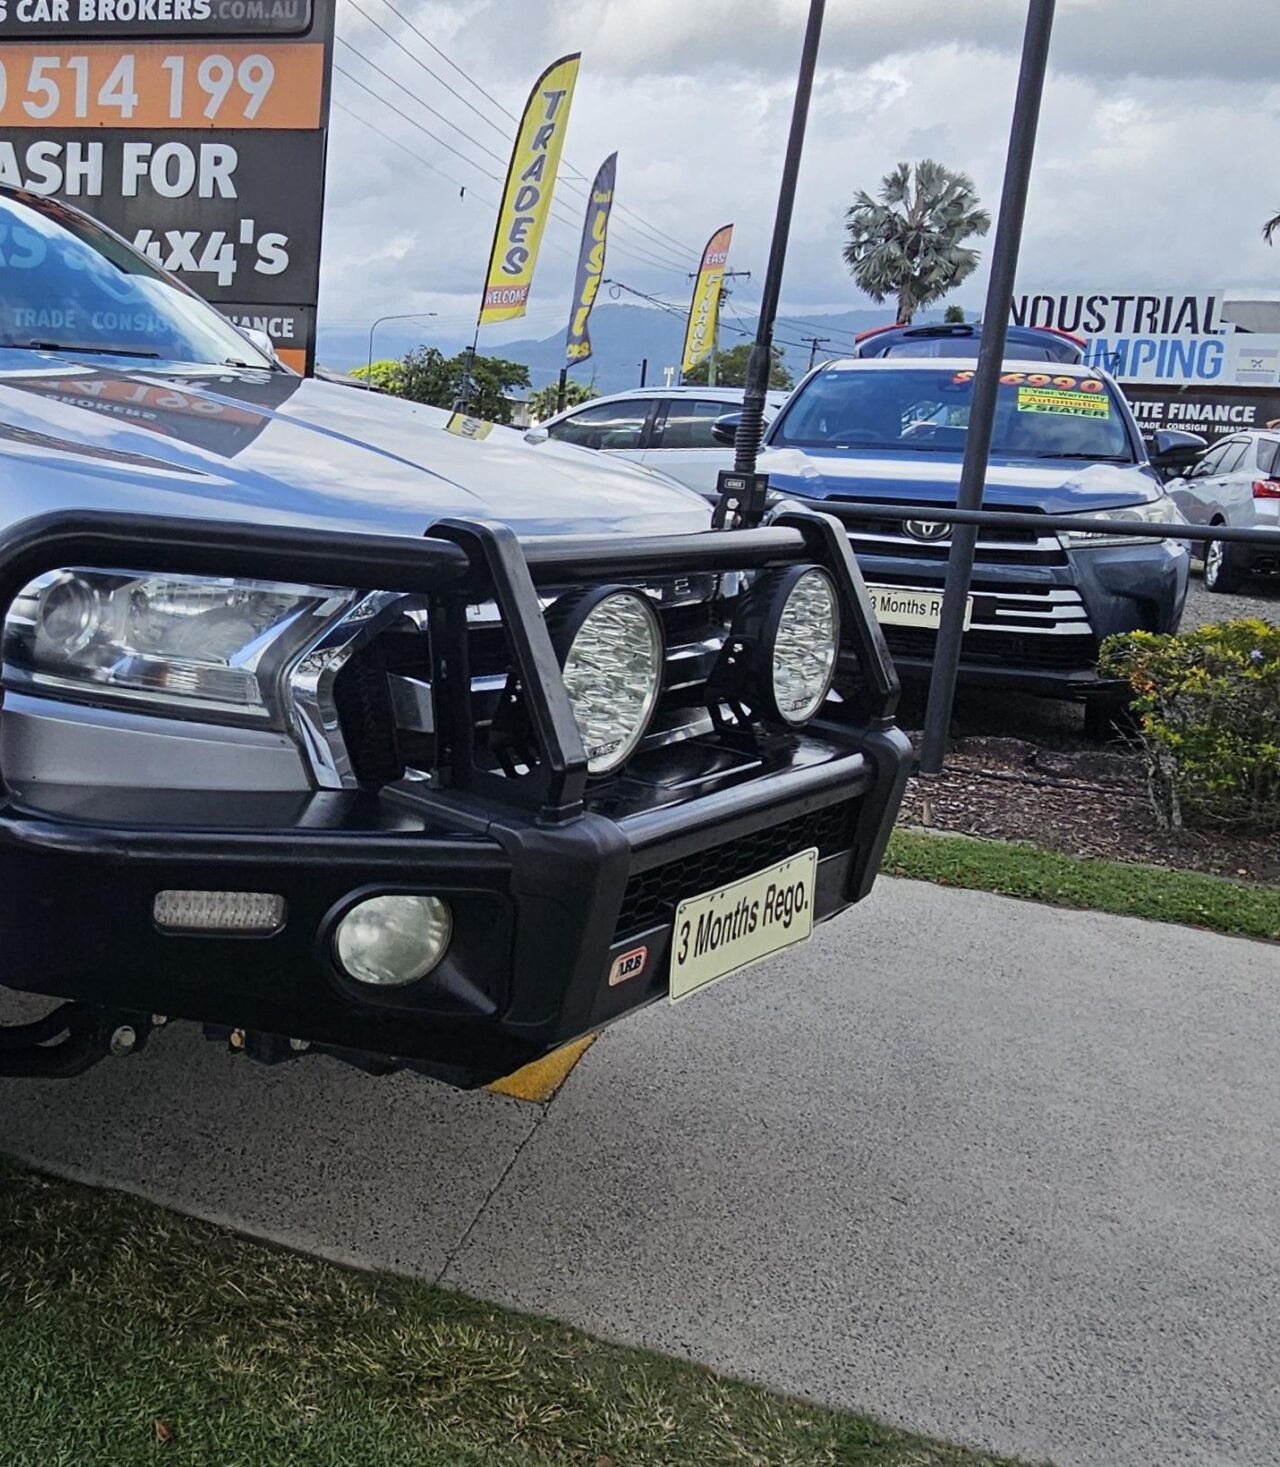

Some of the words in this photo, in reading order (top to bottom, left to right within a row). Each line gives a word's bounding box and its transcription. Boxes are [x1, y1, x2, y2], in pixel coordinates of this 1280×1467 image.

[16, 0, 69, 22] CAR
[22, 54, 139, 119] 514
[160, 54, 276, 120] 199
[121, 141, 239, 199] FOR
[500, 89, 567, 276] TRADES
[13, 308, 75, 329] TRADE
[91, 311, 178, 333] CONSIG
[1009, 295, 1225, 335] NDUSTRIAL
[1084, 338, 1225, 380] MPING
[1028, 396, 1100, 409] Automatic
[1034, 405, 1106, 418] SEATER
[1167, 402, 1257, 423] FINANCE
[1166, 422, 1208, 433] CONSIGN
[880, 596, 926, 615] Months
[677, 920, 691, 965] 3
[693, 896, 759, 958] Months
[762, 881, 809, 929] Rego.
